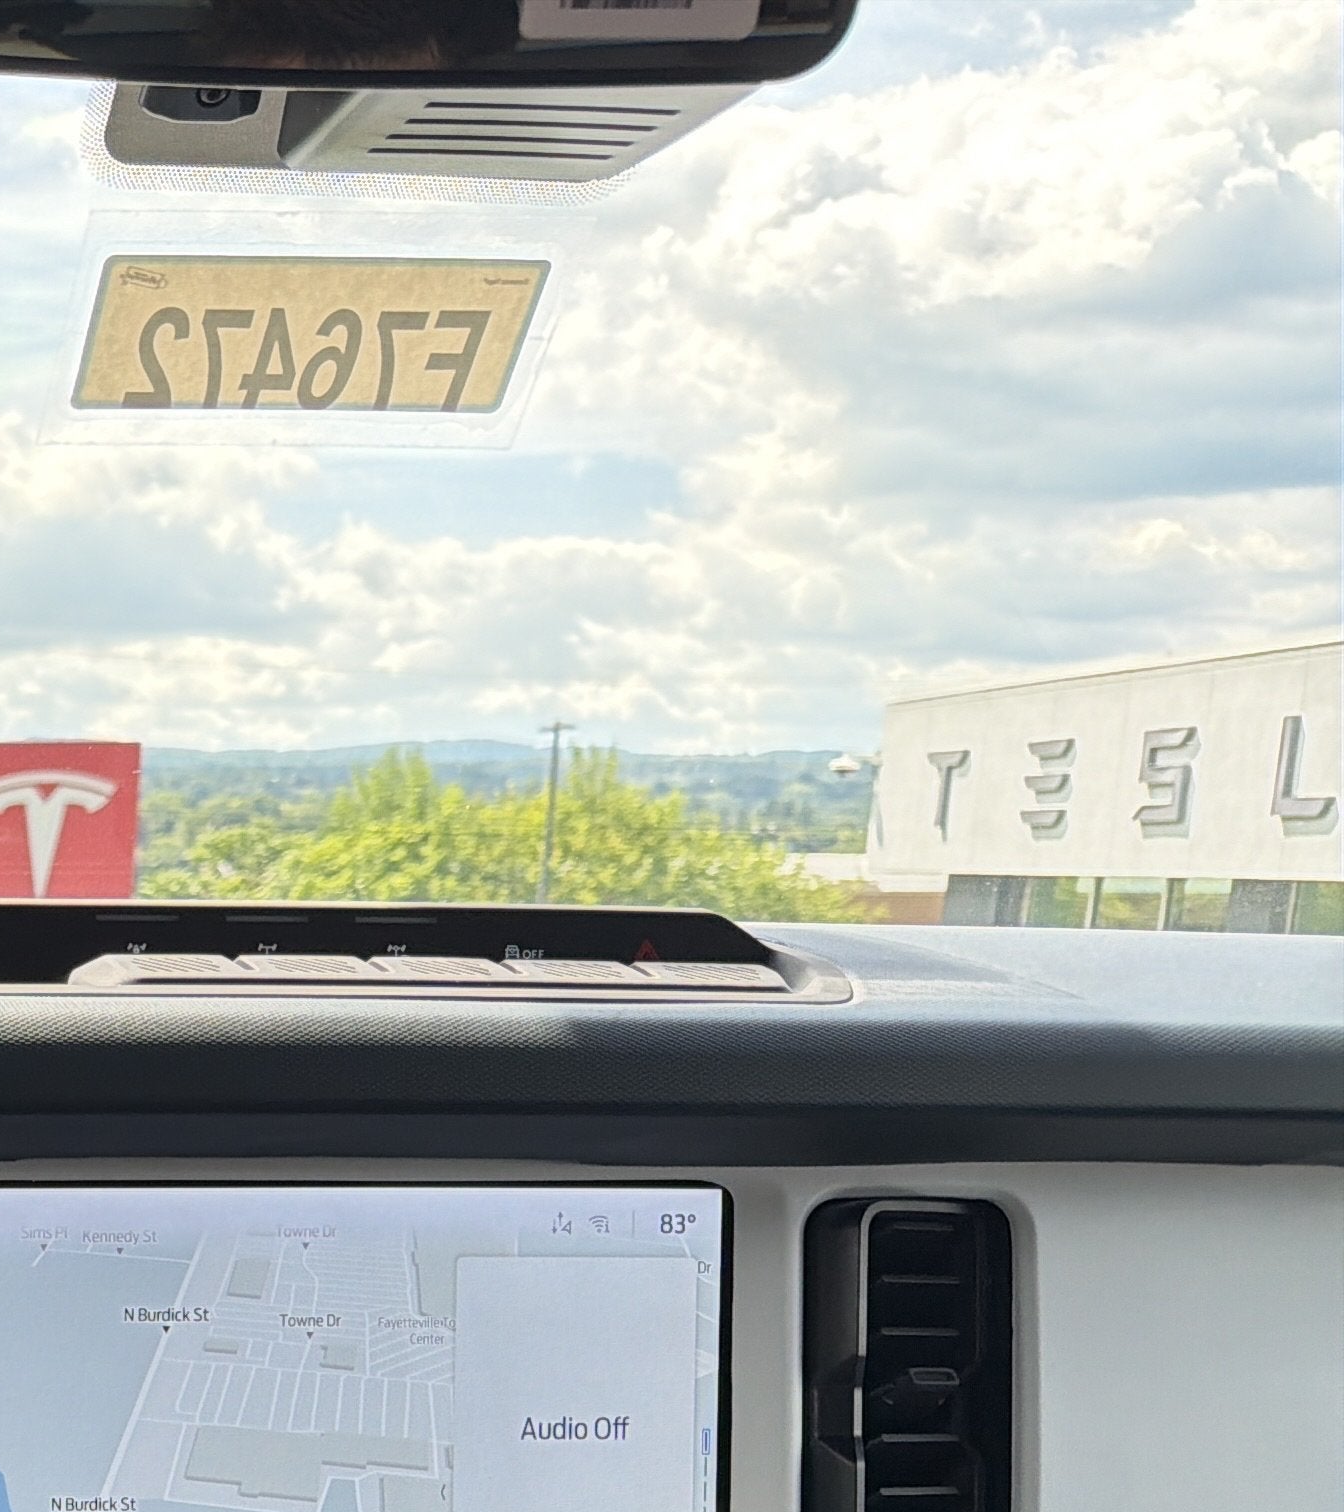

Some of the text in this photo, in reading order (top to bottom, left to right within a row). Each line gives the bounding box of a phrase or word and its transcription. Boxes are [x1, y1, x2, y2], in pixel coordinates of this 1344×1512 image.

[927, 714, 1340, 842] TESL
[522, 949, 545, 961] OFF
[659, 1213, 697, 1234] 83°
[82, 1229, 158, 1247] Kennedy St
[276, 1225, 337, 1239] Towne Dr
[123, 1307, 210, 1323] N Burdick St
[279, 1313, 343, 1329] Towne Dr
[377, 1316, 440, 1331] Fayetteville
[409, 1332, 446, 1346] Center
[520, 1415, 631, 1441] Audio Off
[51, 1497, 137, 1512] N Burdick St
